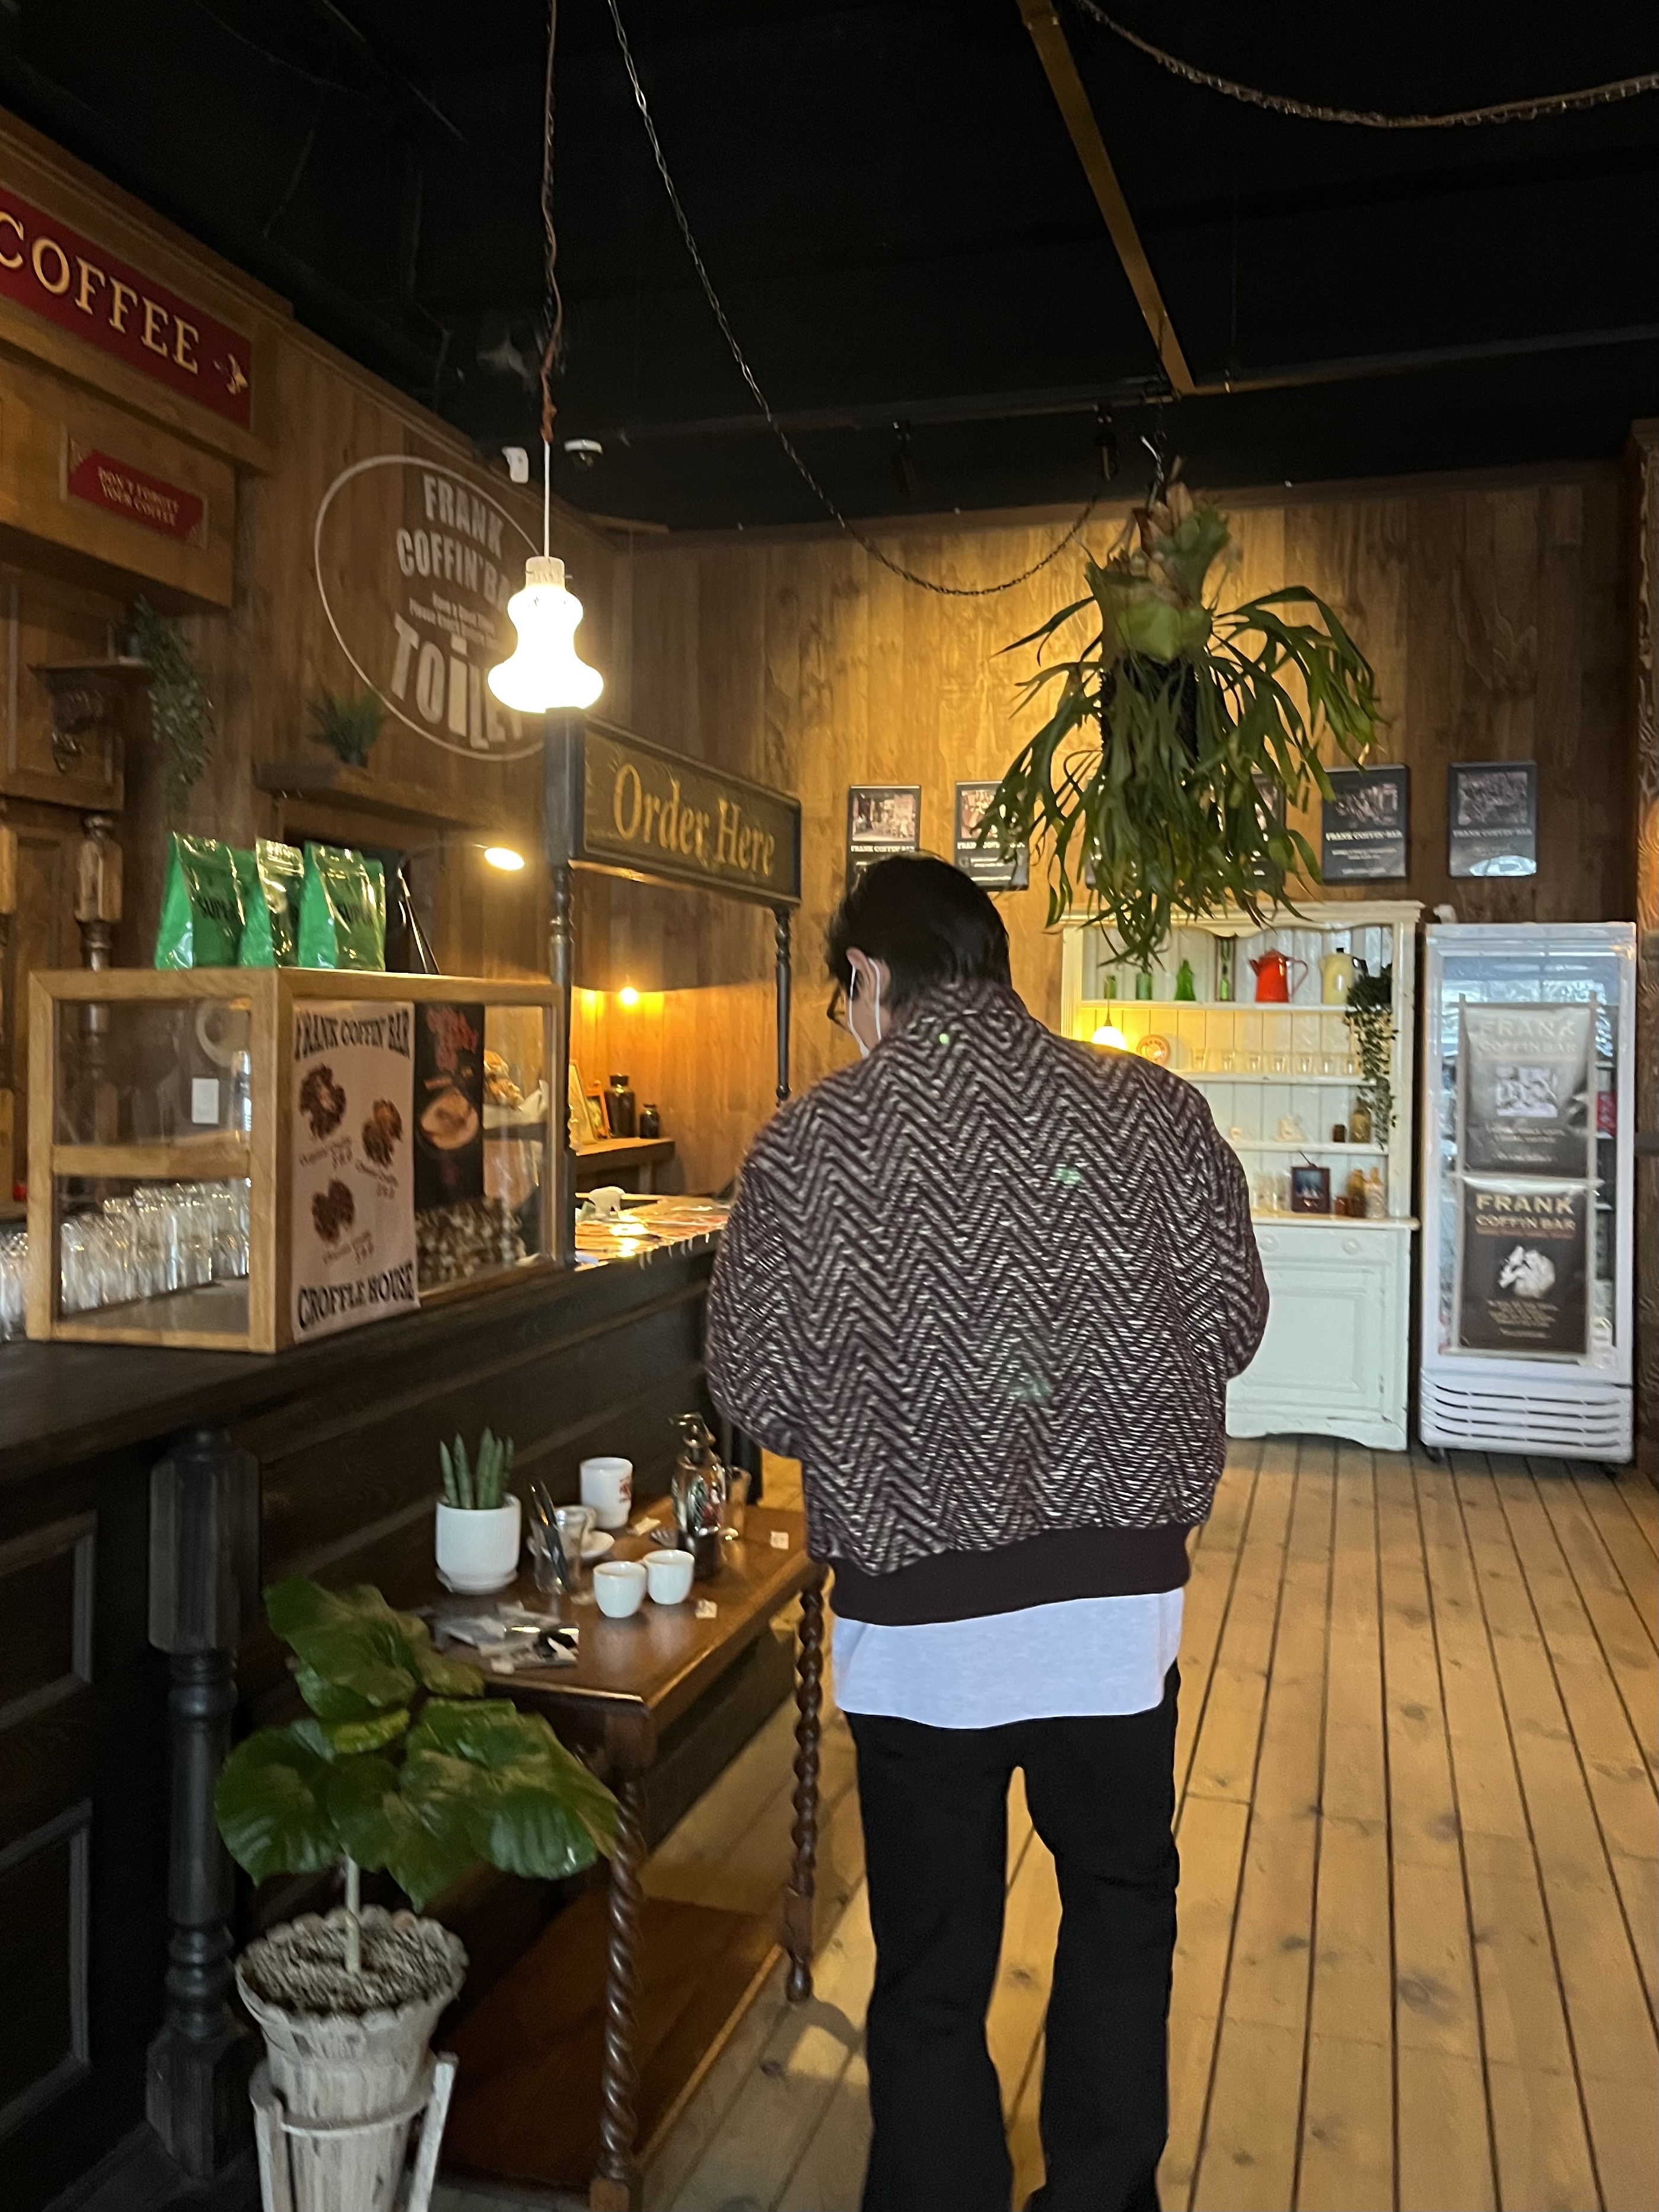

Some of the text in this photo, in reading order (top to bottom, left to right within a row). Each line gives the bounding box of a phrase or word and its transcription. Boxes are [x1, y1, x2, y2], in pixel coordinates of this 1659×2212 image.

[0, 211, 199, 375] COFFEE
[423, 473, 504, 559] FRANK
[613, 763, 775, 877] Order Here
[1476, 1193, 1574, 1215] FRANK
